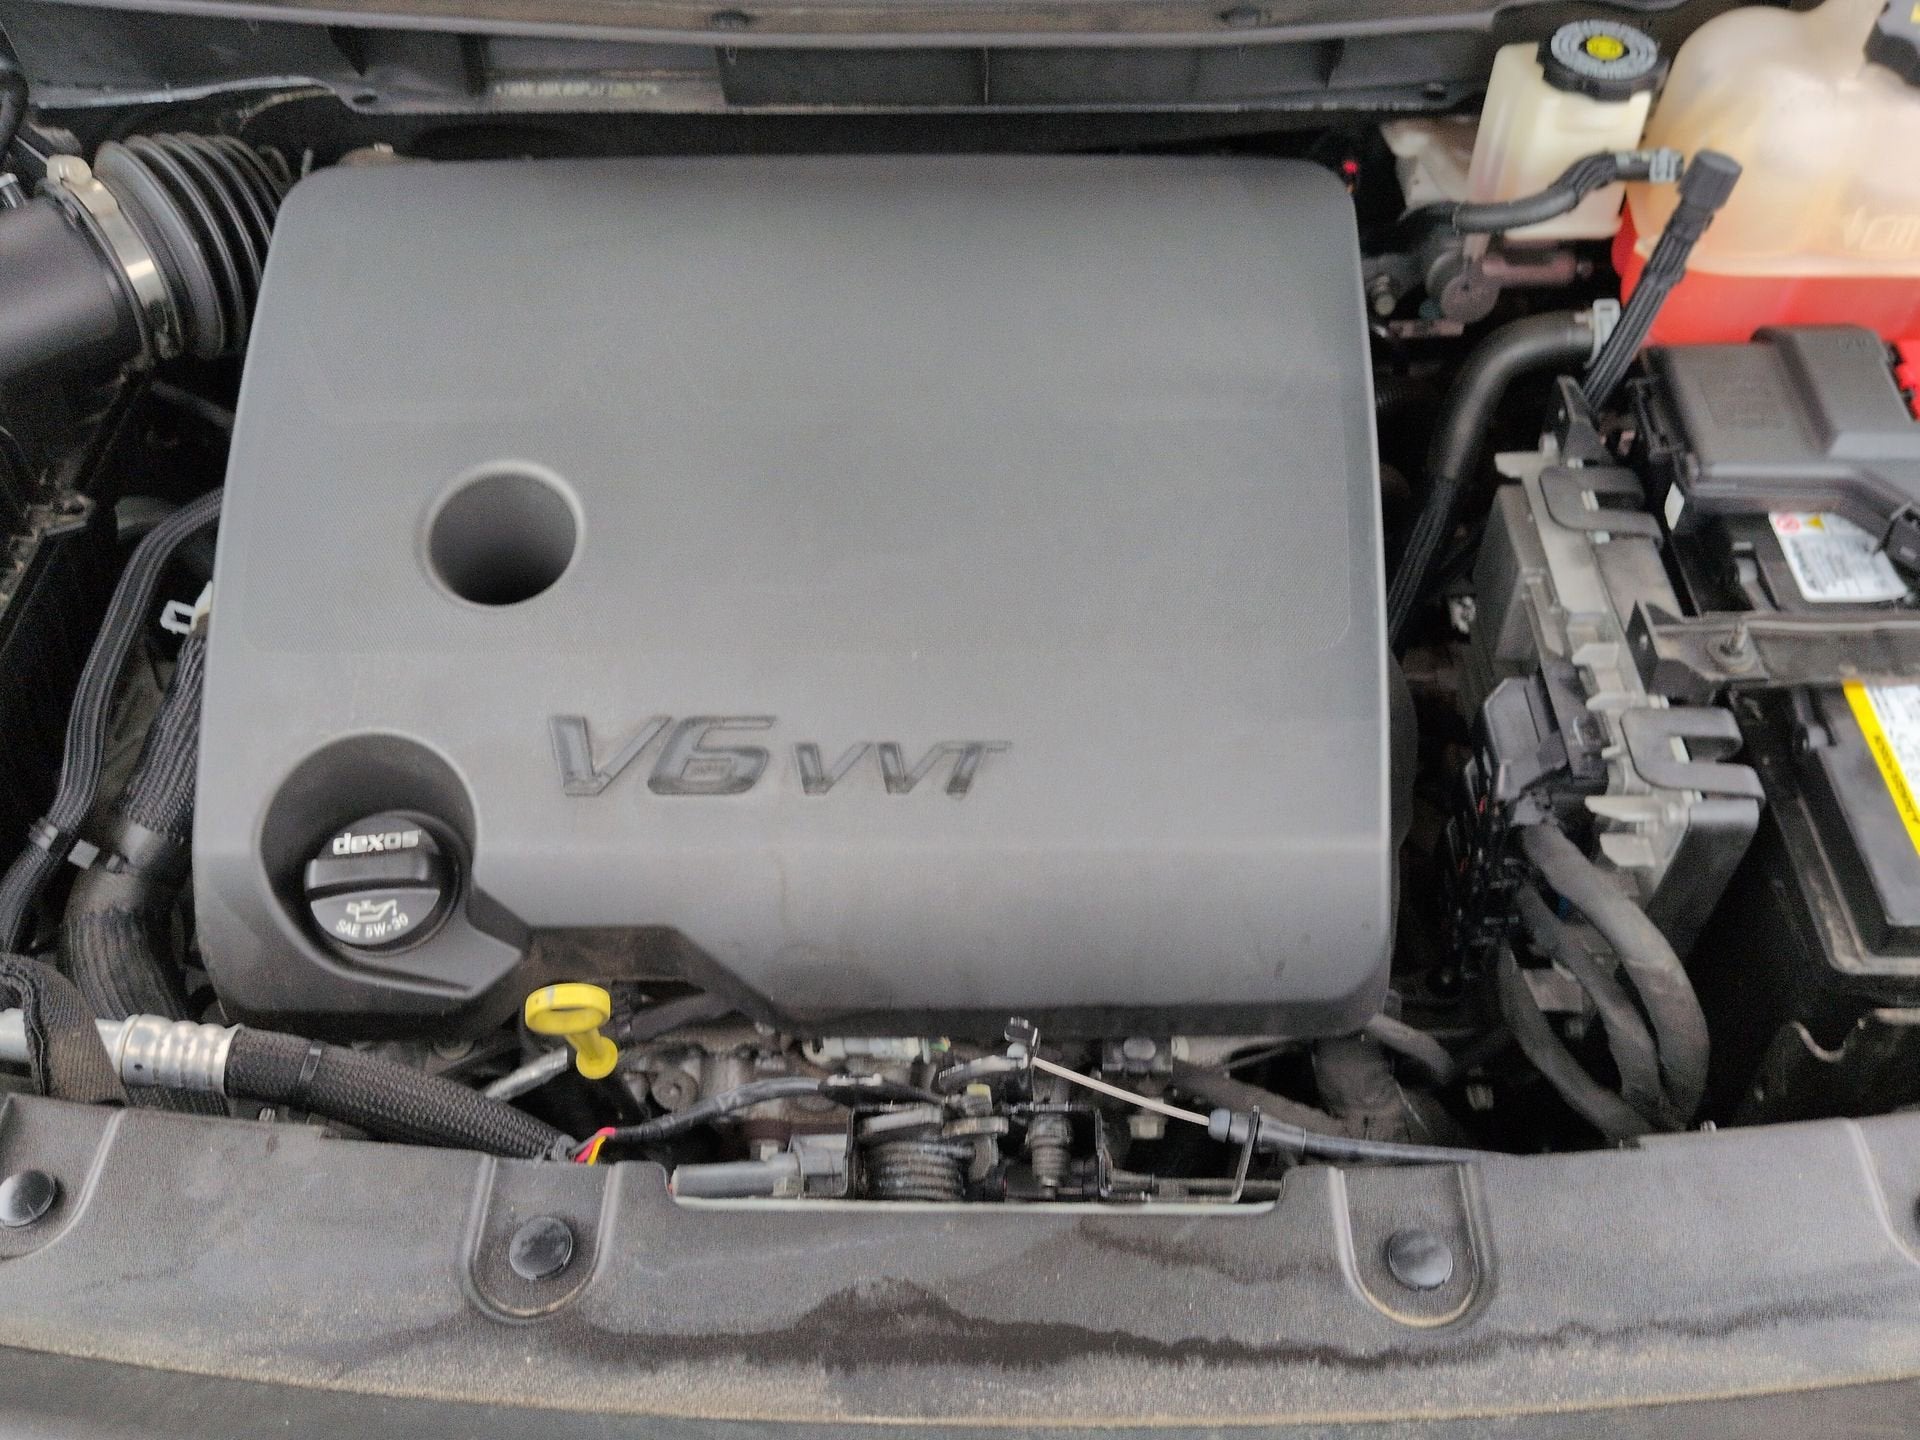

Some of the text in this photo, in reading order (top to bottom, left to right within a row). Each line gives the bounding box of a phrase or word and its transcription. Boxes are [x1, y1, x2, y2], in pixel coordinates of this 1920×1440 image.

[549, 715, 1012, 796] V6 VVT
[332, 831, 420, 855] dexos
[336, 912, 409, 939] SAE 5W-30
